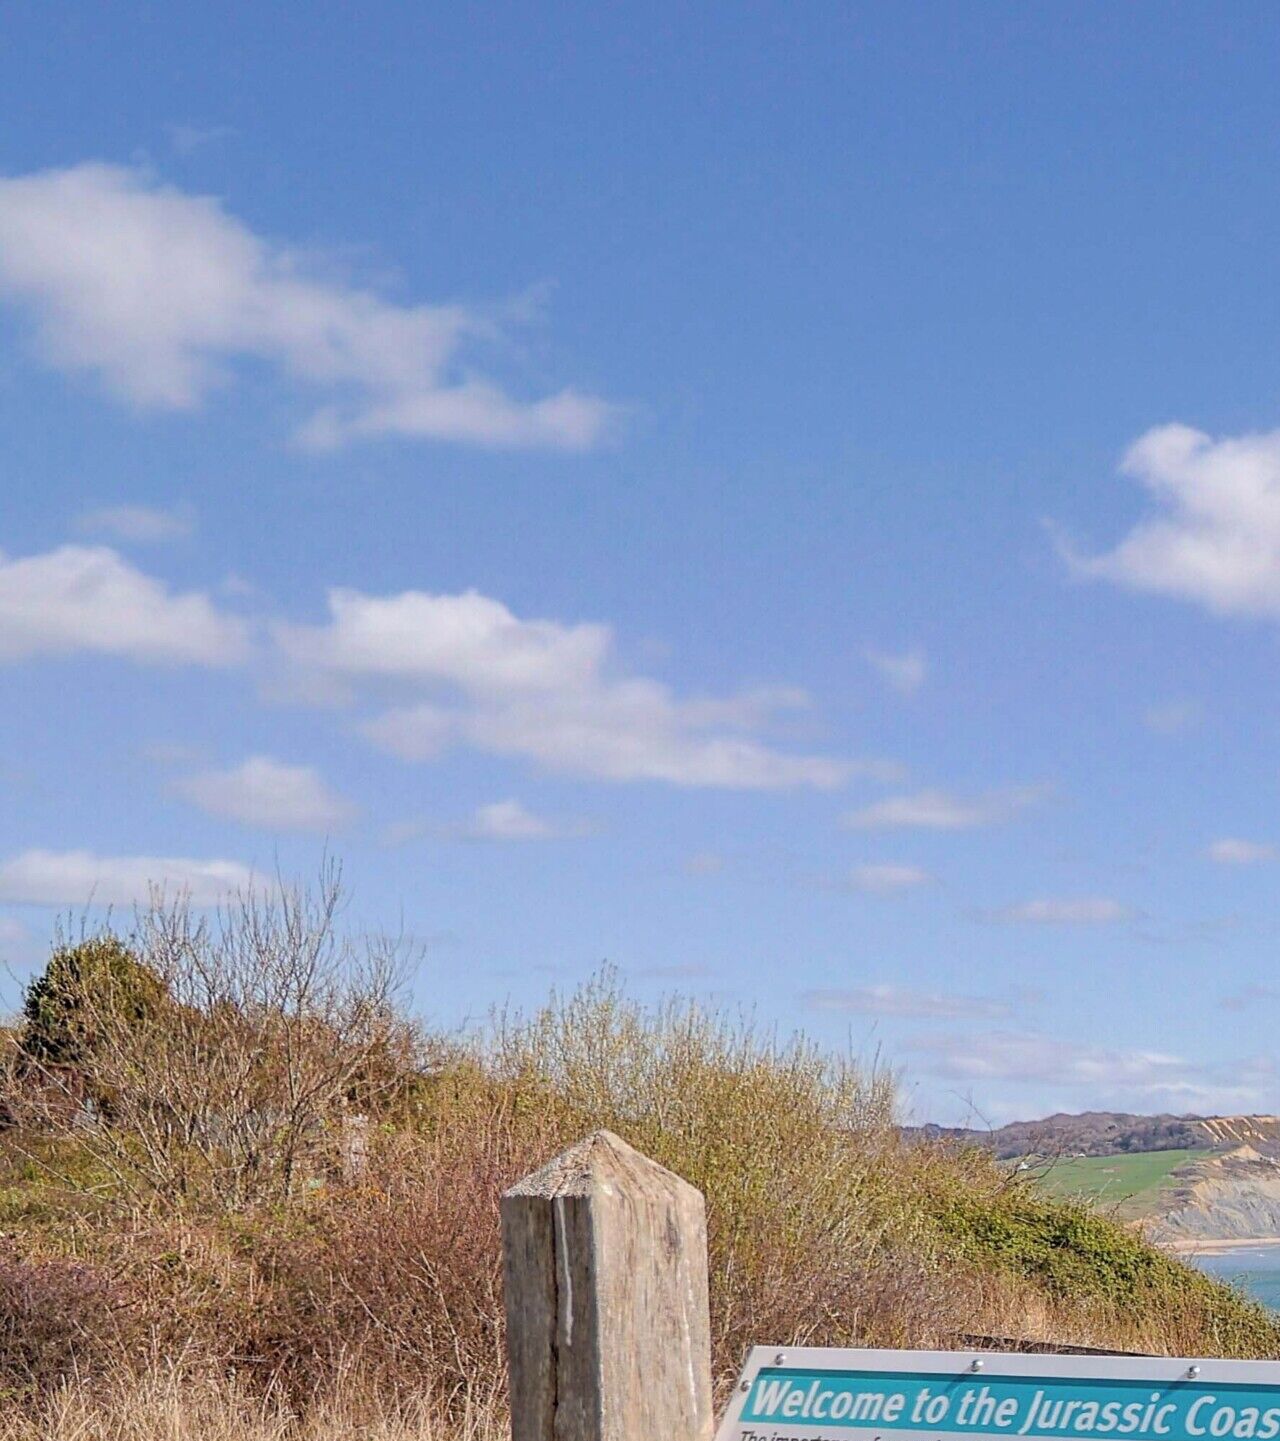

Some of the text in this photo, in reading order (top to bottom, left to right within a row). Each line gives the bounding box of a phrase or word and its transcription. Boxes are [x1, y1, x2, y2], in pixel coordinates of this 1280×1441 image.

[750, 1380, 903, 1423] Welcome
[911, 1392, 947, 1425] to
[956, 1390, 1016, 1427] the
[1018, 1391, 1178, 1436] Jurassic
